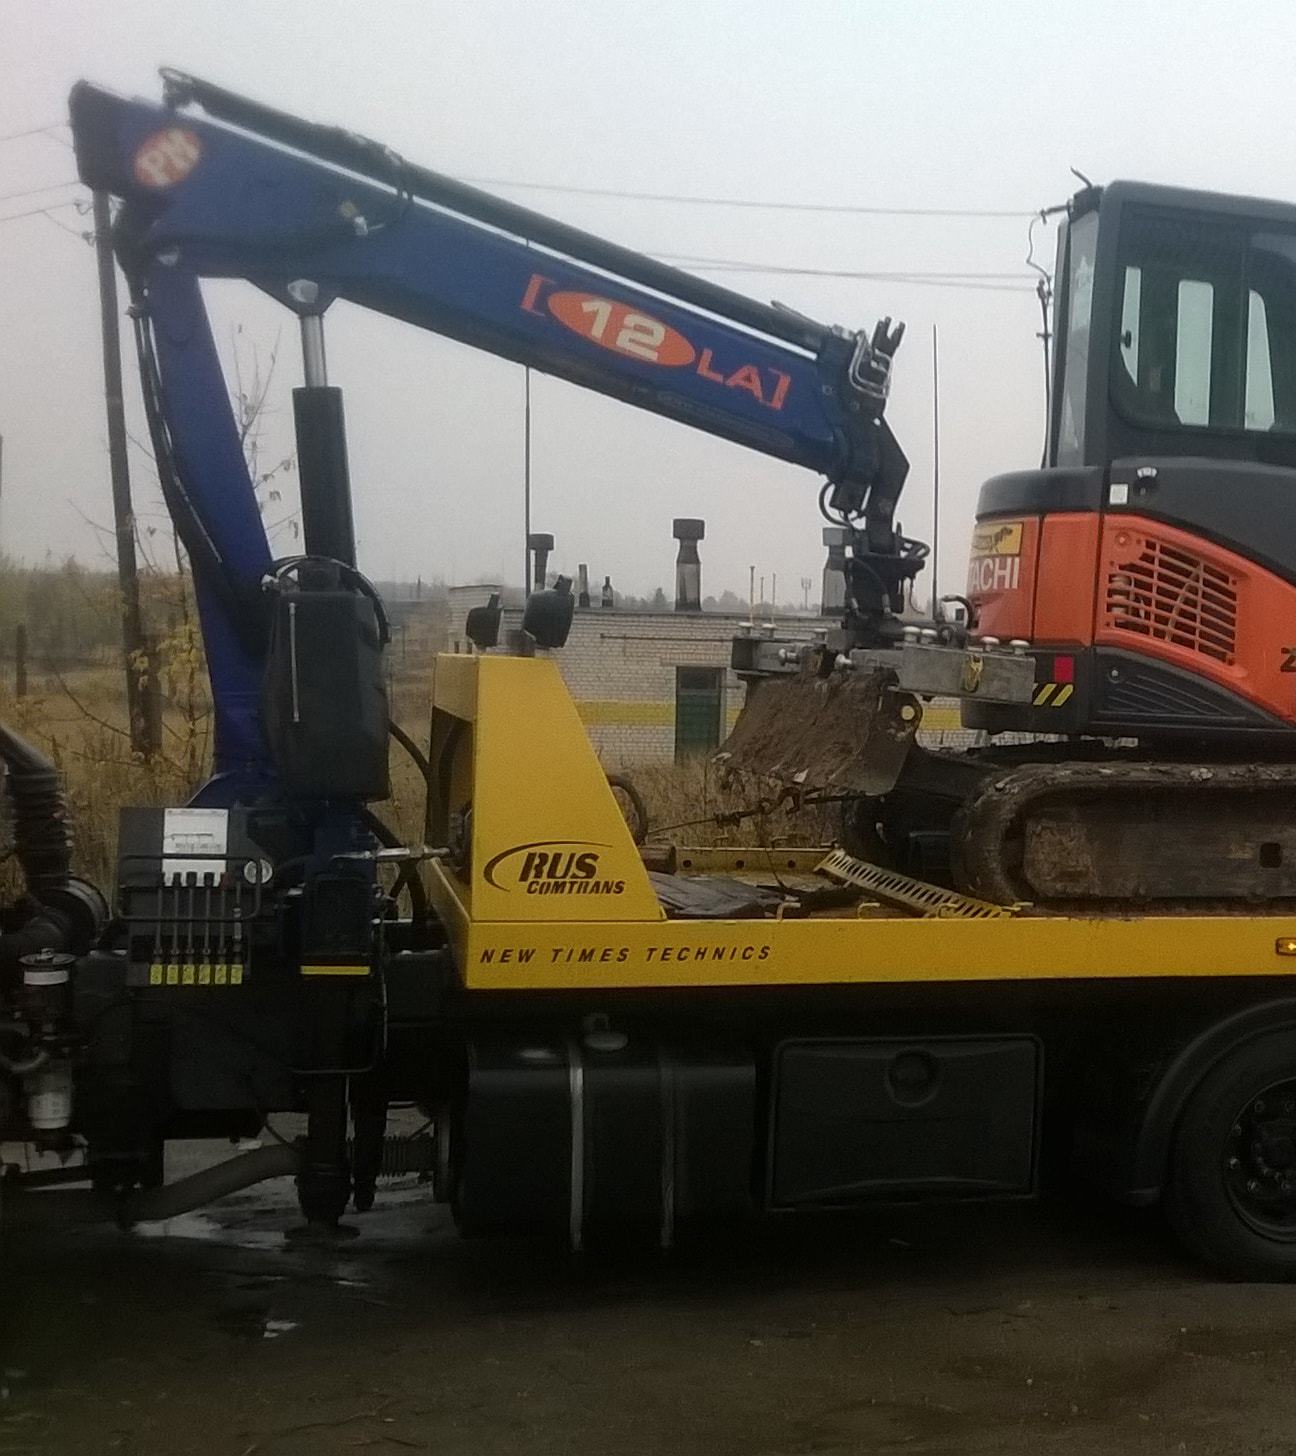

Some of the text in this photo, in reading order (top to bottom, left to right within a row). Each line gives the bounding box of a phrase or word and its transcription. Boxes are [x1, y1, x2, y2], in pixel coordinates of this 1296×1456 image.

[581, 299, 667, 362] 12
[969, 557, 1020, 592] ACHI
[518, 852, 600, 882] RUS
[526, 880, 626, 895] COMTRANS
[479, 945, 771, 964] NEW TIMES TECHNICS
